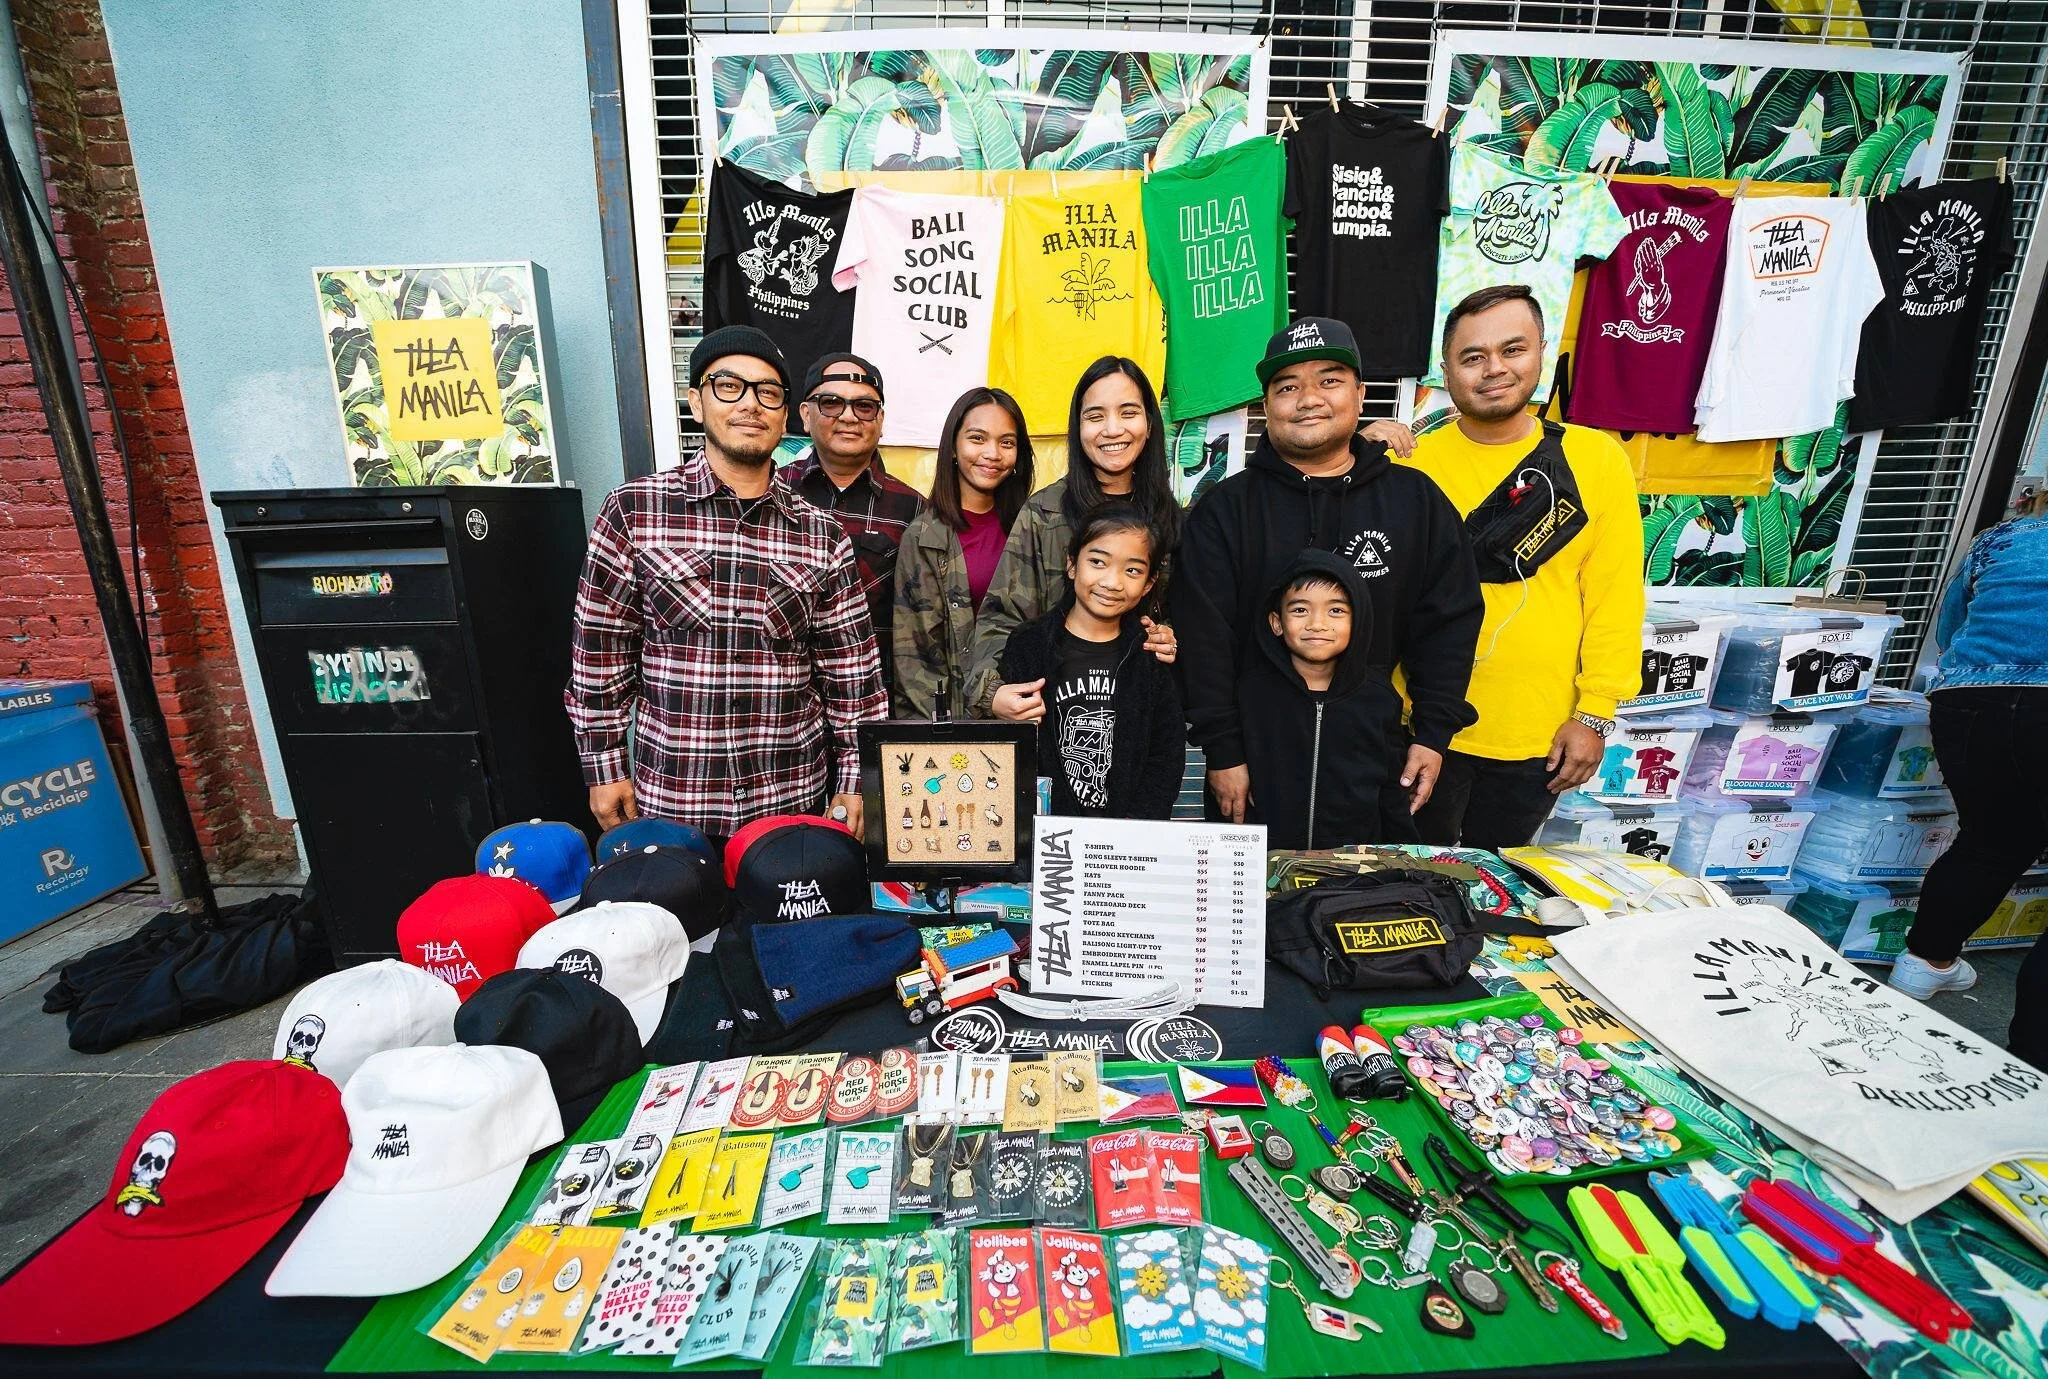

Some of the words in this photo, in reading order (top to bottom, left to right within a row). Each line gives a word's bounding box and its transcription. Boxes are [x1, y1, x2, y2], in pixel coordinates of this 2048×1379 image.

[1333, 164, 1384, 188] Sisig&
[1333, 181, 1395, 203] Pancit&
[1064, 203, 1117, 226] ILLA
[1179, 196, 1250, 242] ILLA
[1333, 199, 1393, 220] dobo&
[742, 200, 776, 226] Illa
[780, 204, 837, 242] Manila
[911, 211, 965, 240] BALI
[1333, 220, 1392, 240] umpia.
[1474, 215, 1538, 248] Manila
[1661, 205, 1711, 243] Manila
[1898, 210, 1934, 254] ILLA
[1938, 199, 1985, 244] MANILA
[1043, 227, 1138, 255] MANILA
[1763, 219, 1805, 247] ILLA
[904, 240, 974, 268] SONG
[1186, 234, 1257, 281] ILLA
[1759, 244, 1812, 274] MANILA
[893, 270, 982, 300] SOCIAL
[1193, 270, 1264, 319] ILLA
[747, 284, 810, 311] Philippines
[908, 303, 968, 330] CLUB
[1287, 322, 1320, 342] ILLA
[1620, 321, 1670, 342] Philippines
[394, 337, 469, 377] ILLA
[399, 378, 493, 421] MANILA
[1344, 534, 1363, 556] ILLA
[1363, 530, 1392, 553] MANILA
[312, 573, 393, 593] BIOHAZARD
[1656, 634, 1674, 644] BOX
[1678, 633, 1684, 641] 2
[1822, 633, 1840, 643] BOX
[1842, 632, 1851, 640] 12
[1672, 664, 1691, 673] SONG
[1674, 657, 1689, 667] BALI
[1669, 669, 1692, 679] SOCIAL
[1056, 677, 1087, 703] LLA
[1655, 692, 1684, 704] SOCIAL
[1685, 689, 1705, 699] CLUB
[1793, 697, 1818, 707] PEACE
[1818, 695, 1834, 703] NOT
[1836, 692, 1854, 700] WAR
[1633, 734, 1654, 742] BOX
[0, 760, 97, 812] CYCLE
[1725, 780, 1764, 788] BLOODLINE
[22, 788, 89, 819] Reciclaje
[1128, 855, 1158, 863] T-SHIRTS
[36, 865, 90, 894] Recology
[1040, 829, 1075, 916] MANILA
[778, 879, 821, 900] ILLA
[777, 897, 832, 920] MANILA
[970, 903, 1000, 911] WARNING
[1083, 900, 1127, 908] SKATEBOARD
[1893, 899, 1911, 907] BOX
[1116, 932, 1155, 940] KEYCHAINS
[1345, 927, 1384, 949] ILLA
[1383, 921, 1436, 946] MANILA
[416, 940, 466, 962] ILLA
[1038, 919, 1073, 985] ILLA
[1082, 950, 1127, 959] EMBROIDERY
[1081, 979, 1113, 987] STICKERS
[1159, 1028, 1212, 1043] MANILA
[1165, 1020, 1195, 1031] ILLA
[1004, 1028, 1050, 1049] ILLA
[1053, 1033, 1117, 1051] MANILA
[772, 1058, 792, 1066] HORSE
[799, 1057, 813, 1065] RED
[845, 1077, 864, 1088] RED
[878, 1076, 908, 1090] HORSE
[884, 1069, 902, 1079] RED
[838, 1085, 869, 1098] HORSE
[885, 1087, 901, 1095] BEER
[890, 1085, 916, 1106] STRONG
[1852, 1062, 2048, 1112] PHILIPPINES
[750, 1107, 776, 1121] STRONG
[847, 1095, 875, 1114] STRONG
[381, 1123, 408, 1141] ILLA
[670, 1134, 716, 1150] Balisong
[1092, 1131, 1137, 1154] Coca-Cola
[1148, 1131, 1195, 1152] Coca-Cola
[371, 1140, 410, 1160] MANILA
[722, 1140, 768, 1152] Balisong
[974, 1235, 1028, 1248] Jollibee
[1045, 1235, 1098, 1253] Jollibee
[729, 1244, 760, 1268] MANILA
[779, 1241, 802, 1273] MANILA
[603, 1289, 650, 1310] HELLO
[607, 1280, 654, 1299] PLAYBOY
[601, 1300, 647, 1321] KITTY
[656, 1303, 688, 1313] ELLO
[700, 1309, 734, 1325] CLUB
